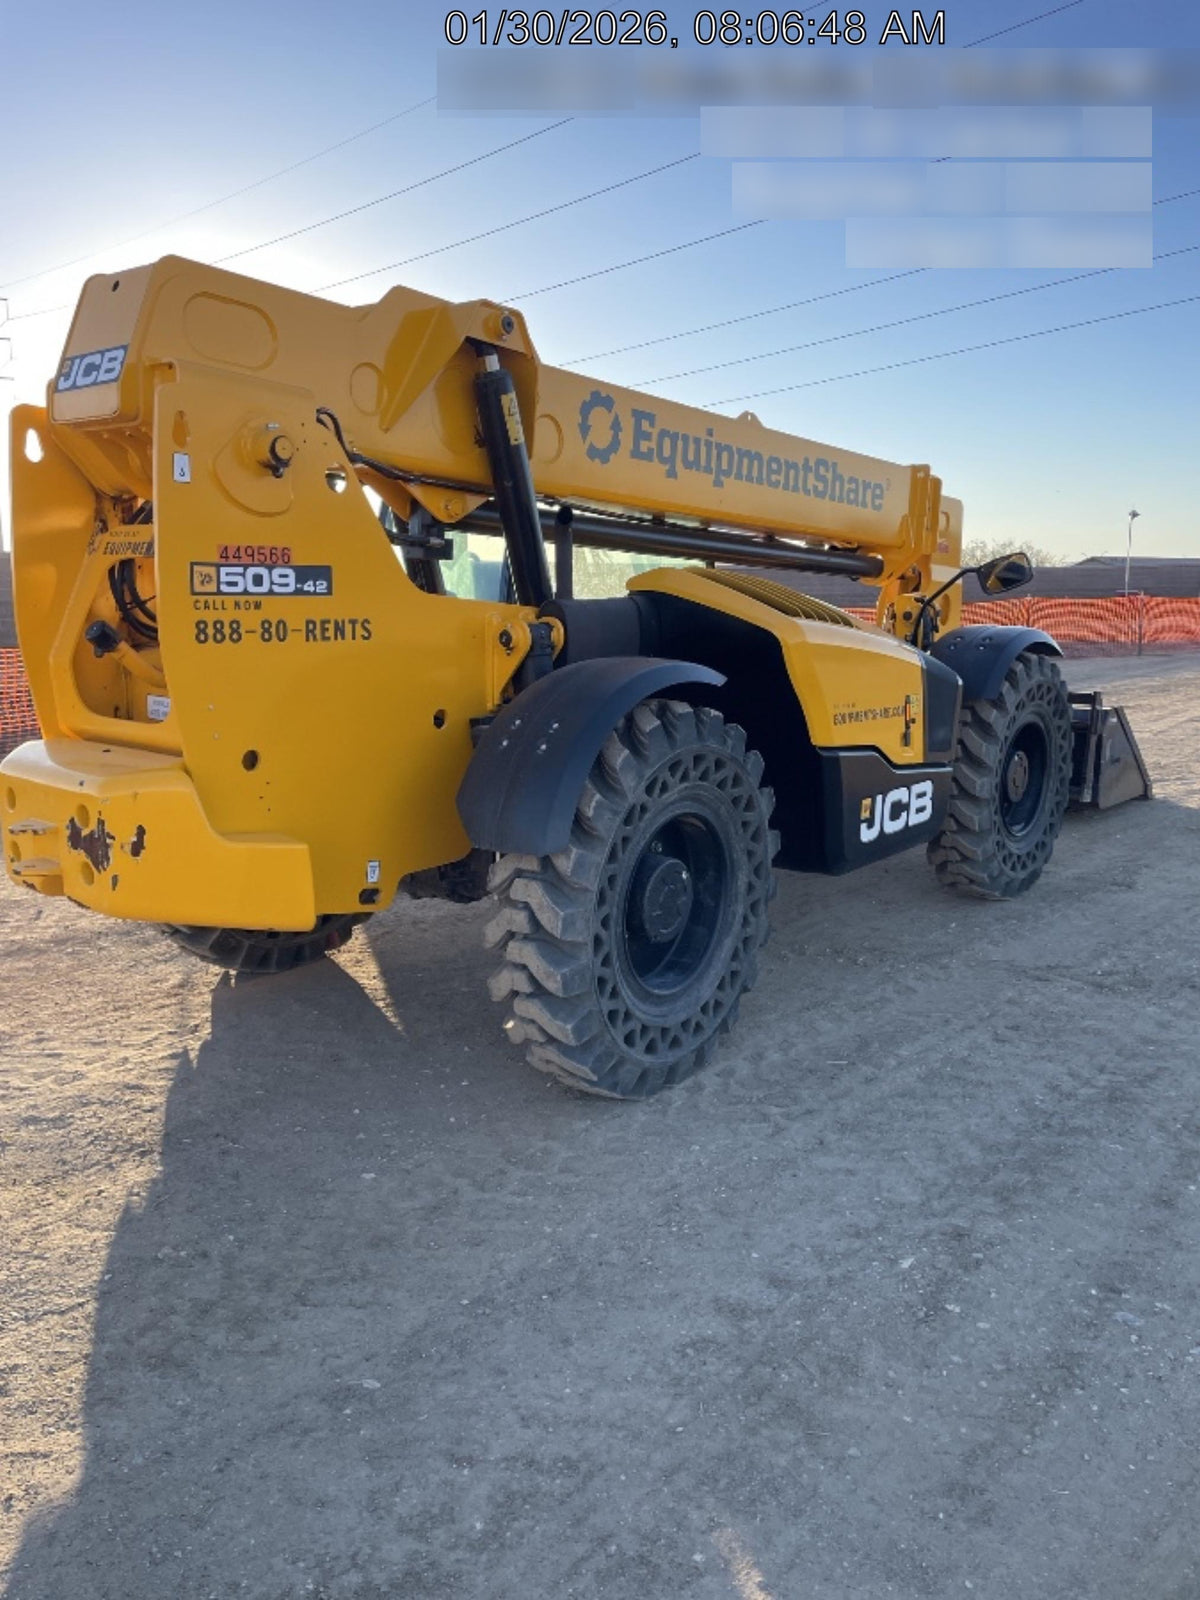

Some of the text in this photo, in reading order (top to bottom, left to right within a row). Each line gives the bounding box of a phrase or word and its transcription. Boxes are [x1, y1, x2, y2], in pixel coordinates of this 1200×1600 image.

[57, 348, 126, 391] JCB
[630, 408, 885, 512] EquipmentShare
[219, 545, 291, 564] 449566
[193, 599, 262, 611] CALL NOW
[194, 618, 372, 645] 888-80-RENTS
[860, 780, 933, 843] JCB
